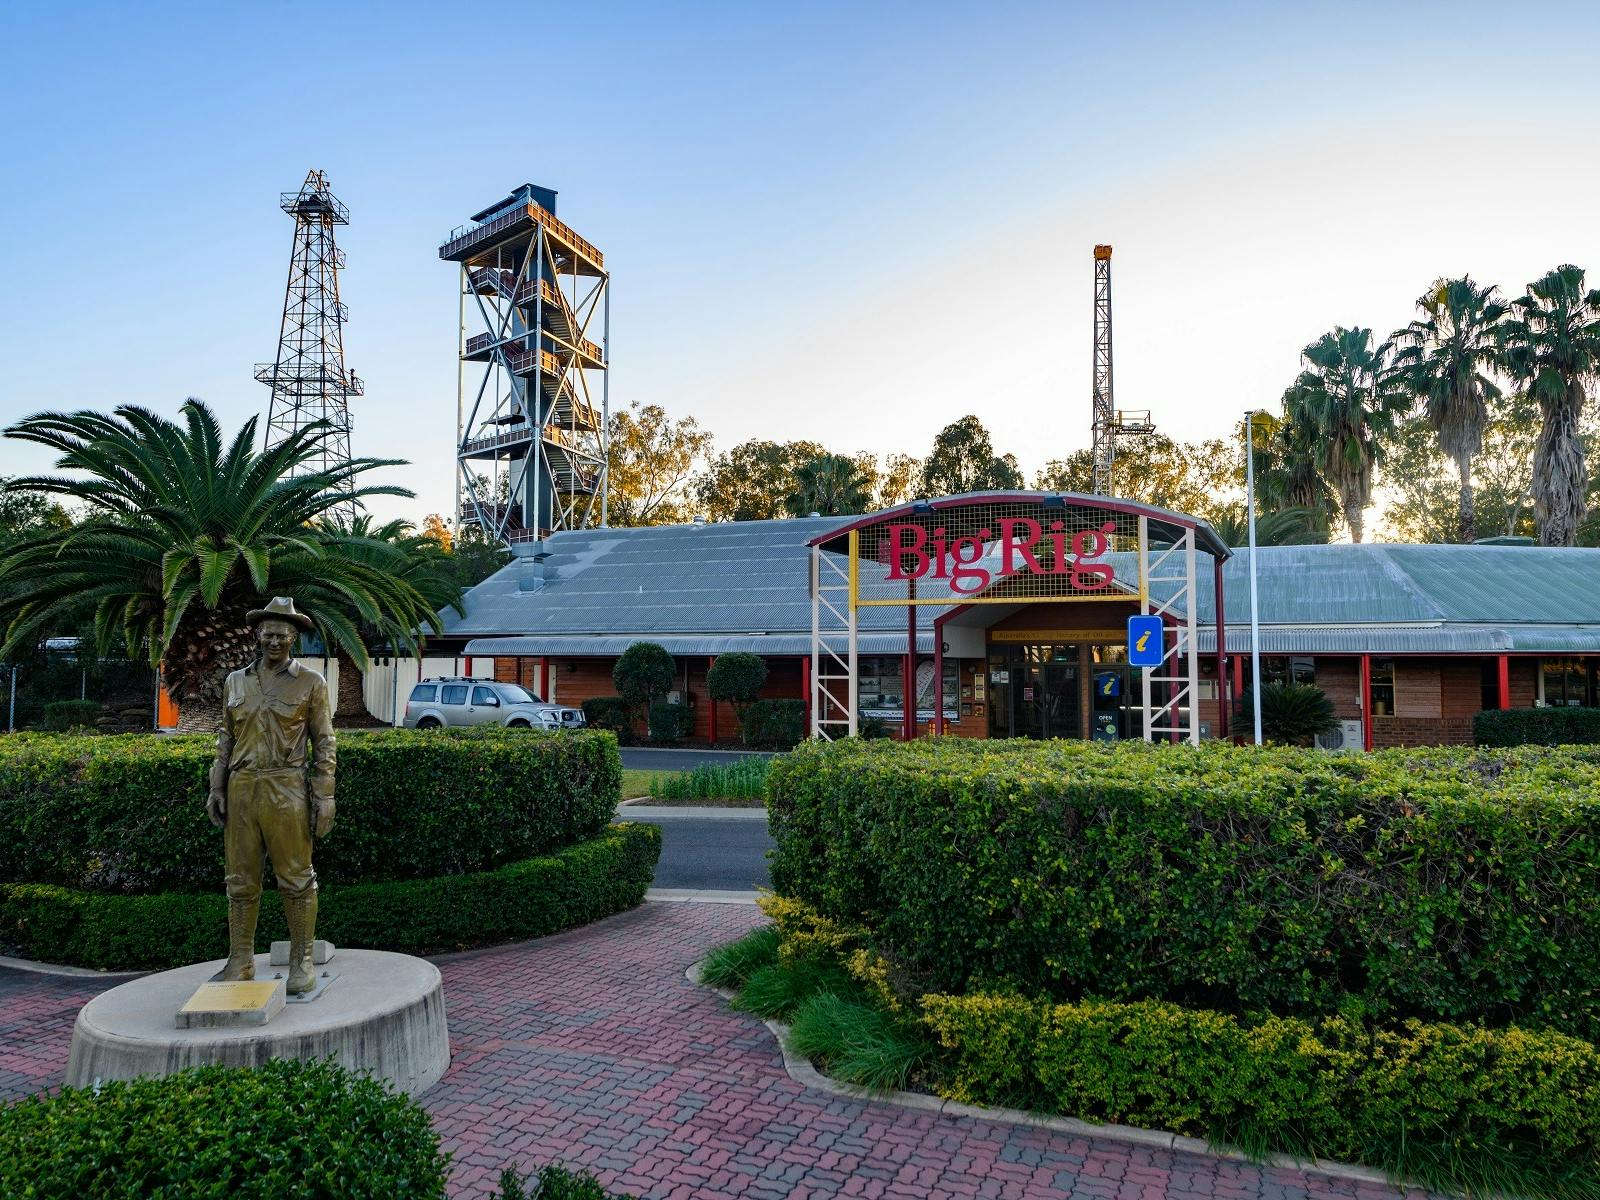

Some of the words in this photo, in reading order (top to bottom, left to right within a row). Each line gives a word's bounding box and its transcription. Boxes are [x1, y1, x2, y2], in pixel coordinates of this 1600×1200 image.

[884, 523, 991, 594] Big
[995, 517, 1116, 590] Rig
[1136, 630, 1152, 652] i
